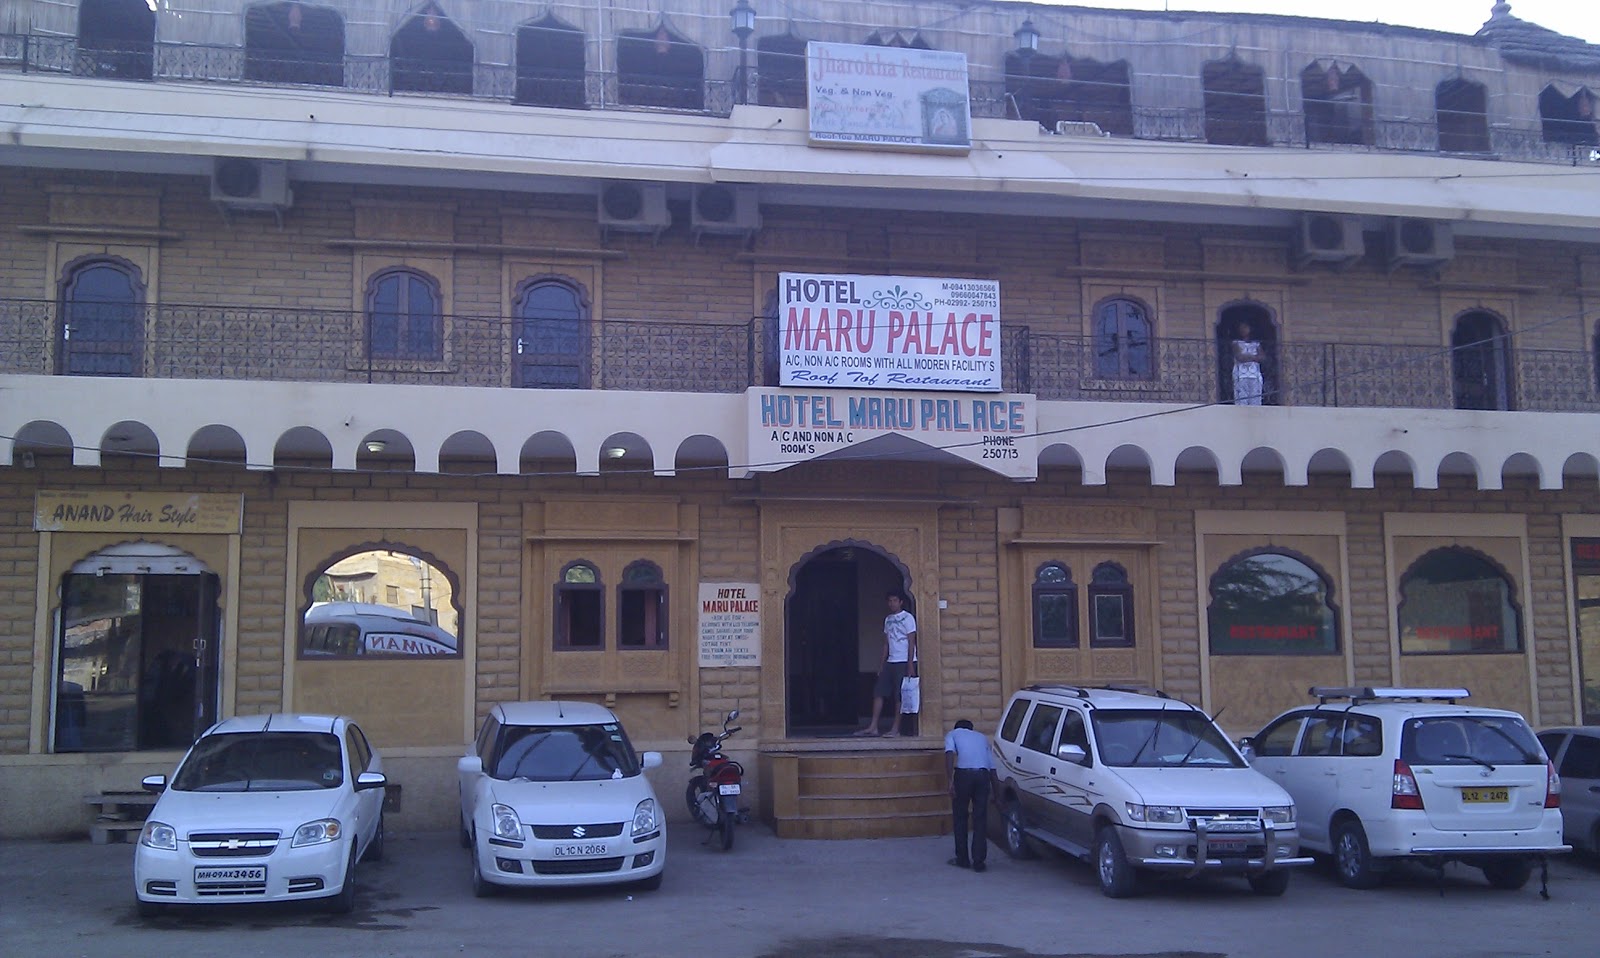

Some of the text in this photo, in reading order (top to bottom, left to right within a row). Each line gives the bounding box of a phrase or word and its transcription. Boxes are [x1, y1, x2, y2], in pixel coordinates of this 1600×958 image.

[813, 47, 898, 81] Jharokha
[815, 86, 837, 96] Veg.
[852, 88, 872, 96] Non
[874, 89, 896, 99] Veg.
[786, 278, 861, 305] HOTEL
[972, 300, 997, 308] 250713
[784, 306, 994, 357] MARU PALACE
[804, 355, 823, 367] NON
[824, 356, 839, 367] A/C
[841, 356, 872, 368] ROOMS
[873, 357, 895, 369] WITH
[896, 358, 913, 369] ALL
[914, 358, 950, 370] MODREN
[790, 370, 839, 384] Roof
[886, 372, 992, 386] Restaurant
[760, 394, 1025, 433] HOTEL MARU PALACE
[792, 431, 812, 442] AND
[814, 432, 834, 443] NON
[983, 435, 1015, 446] PHONE
[780, 443, 816, 454] ROOM'S
[982, 448, 1019, 459] 250713
[53, 503, 115, 522] ANAND
[118, 503, 153, 523] Hair
[158, 503, 197, 528] Style
[717, 588, 747, 599] HOTEL
[702, 600, 759, 613] MARU PALACE
[1230, 624, 1316, 640] RESTAURANT
[1416, 624, 1499, 640] RESTAURANT
